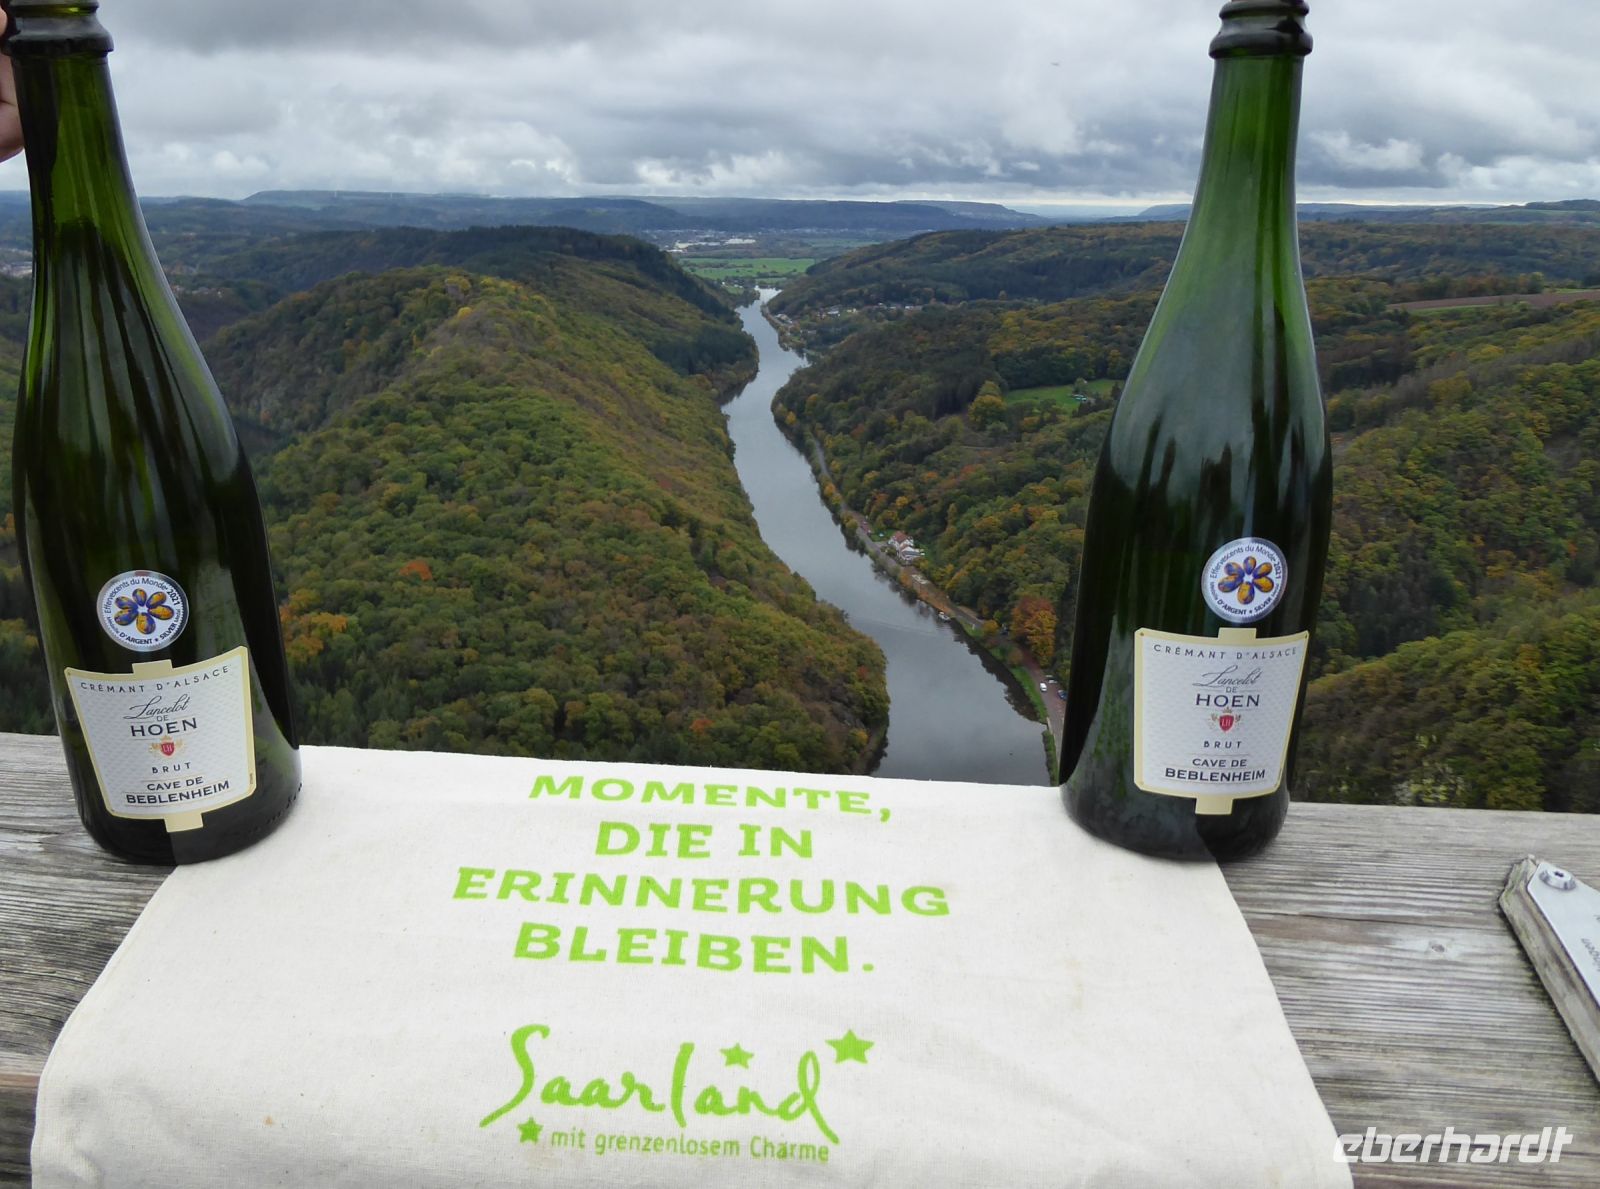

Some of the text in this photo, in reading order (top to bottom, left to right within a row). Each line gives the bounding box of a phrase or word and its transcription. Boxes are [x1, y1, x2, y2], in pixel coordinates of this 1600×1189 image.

[1210, 547, 1243, 578] Effervescents
[1256, 545, 1276, 561] Monde
[1274, 559, 1282, 579] 2021
[104, 582, 130, 614] Effervescents
[141, 578, 167, 590] Monde
[167, 588, 181, 606] 2021
[1217, 597, 1272, 615] D'ARGENT SILVER
[119, 632, 152, 644] D'ARGENT
[160, 623, 177, 639] SILVER
[1153, 644, 1297, 660] CRÉMANT D'ALSACE
[81, 665, 229, 693] CRÉMANT D'ALSACE
[1192, 665, 1262, 688] Lancelot
[124, 693, 191, 720] Lancelot
[1196, 694, 1260, 707] HOEN
[130, 718, 198, 737] HOEN
[152, 762, 191, 774] BRUT
[1192, 758, 1247, 767] CAVE DE
[147, 776, 203, 790] CAVE DE
[1165, 768, 1265, 782] BEBLENHEIM
[126, 780, 230, 804] BEBLENHEIM
[528, 775, 892, 822] MOMENTE,
[595, 821, 812, 858] DIE IN
[453, 866, 950, 917] ERINNERUNG
[513, 922, 874, 974] BLEIBEN.
[480, 1024, 840, 1145] Saarland
[551, 1128, 829, 1163] mit grenzenlosem Charme
